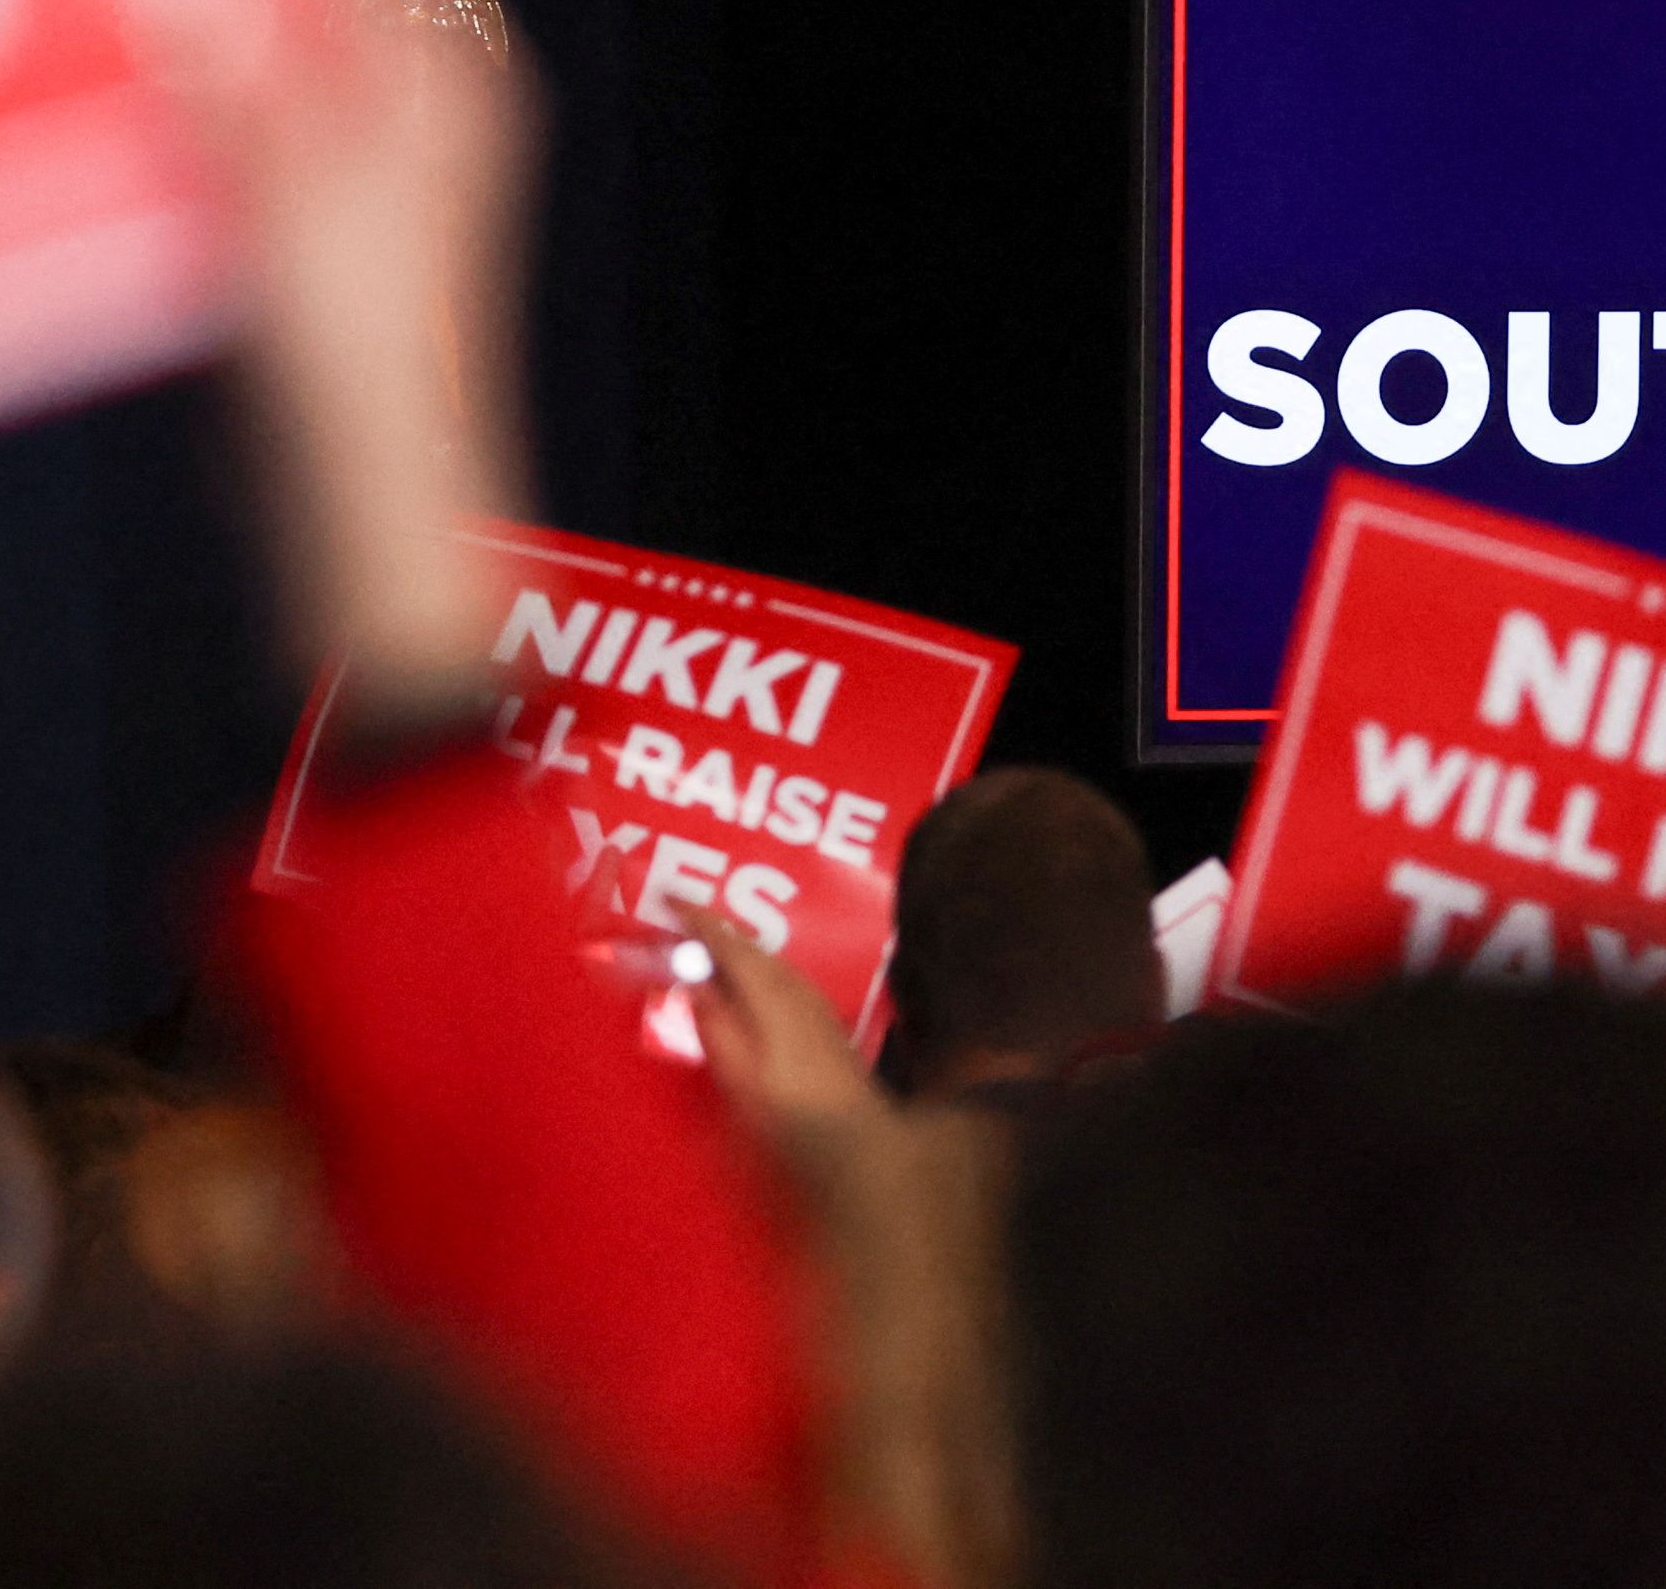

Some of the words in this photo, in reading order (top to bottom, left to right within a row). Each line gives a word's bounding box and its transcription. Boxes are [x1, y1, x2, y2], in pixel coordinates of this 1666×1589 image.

[491, 591, 843, 745] NIKKI
[615, 723, 887, 866] RAISE
[1355, 723, 1619, 881] WILL
[565, 806, 799, 955] XES
